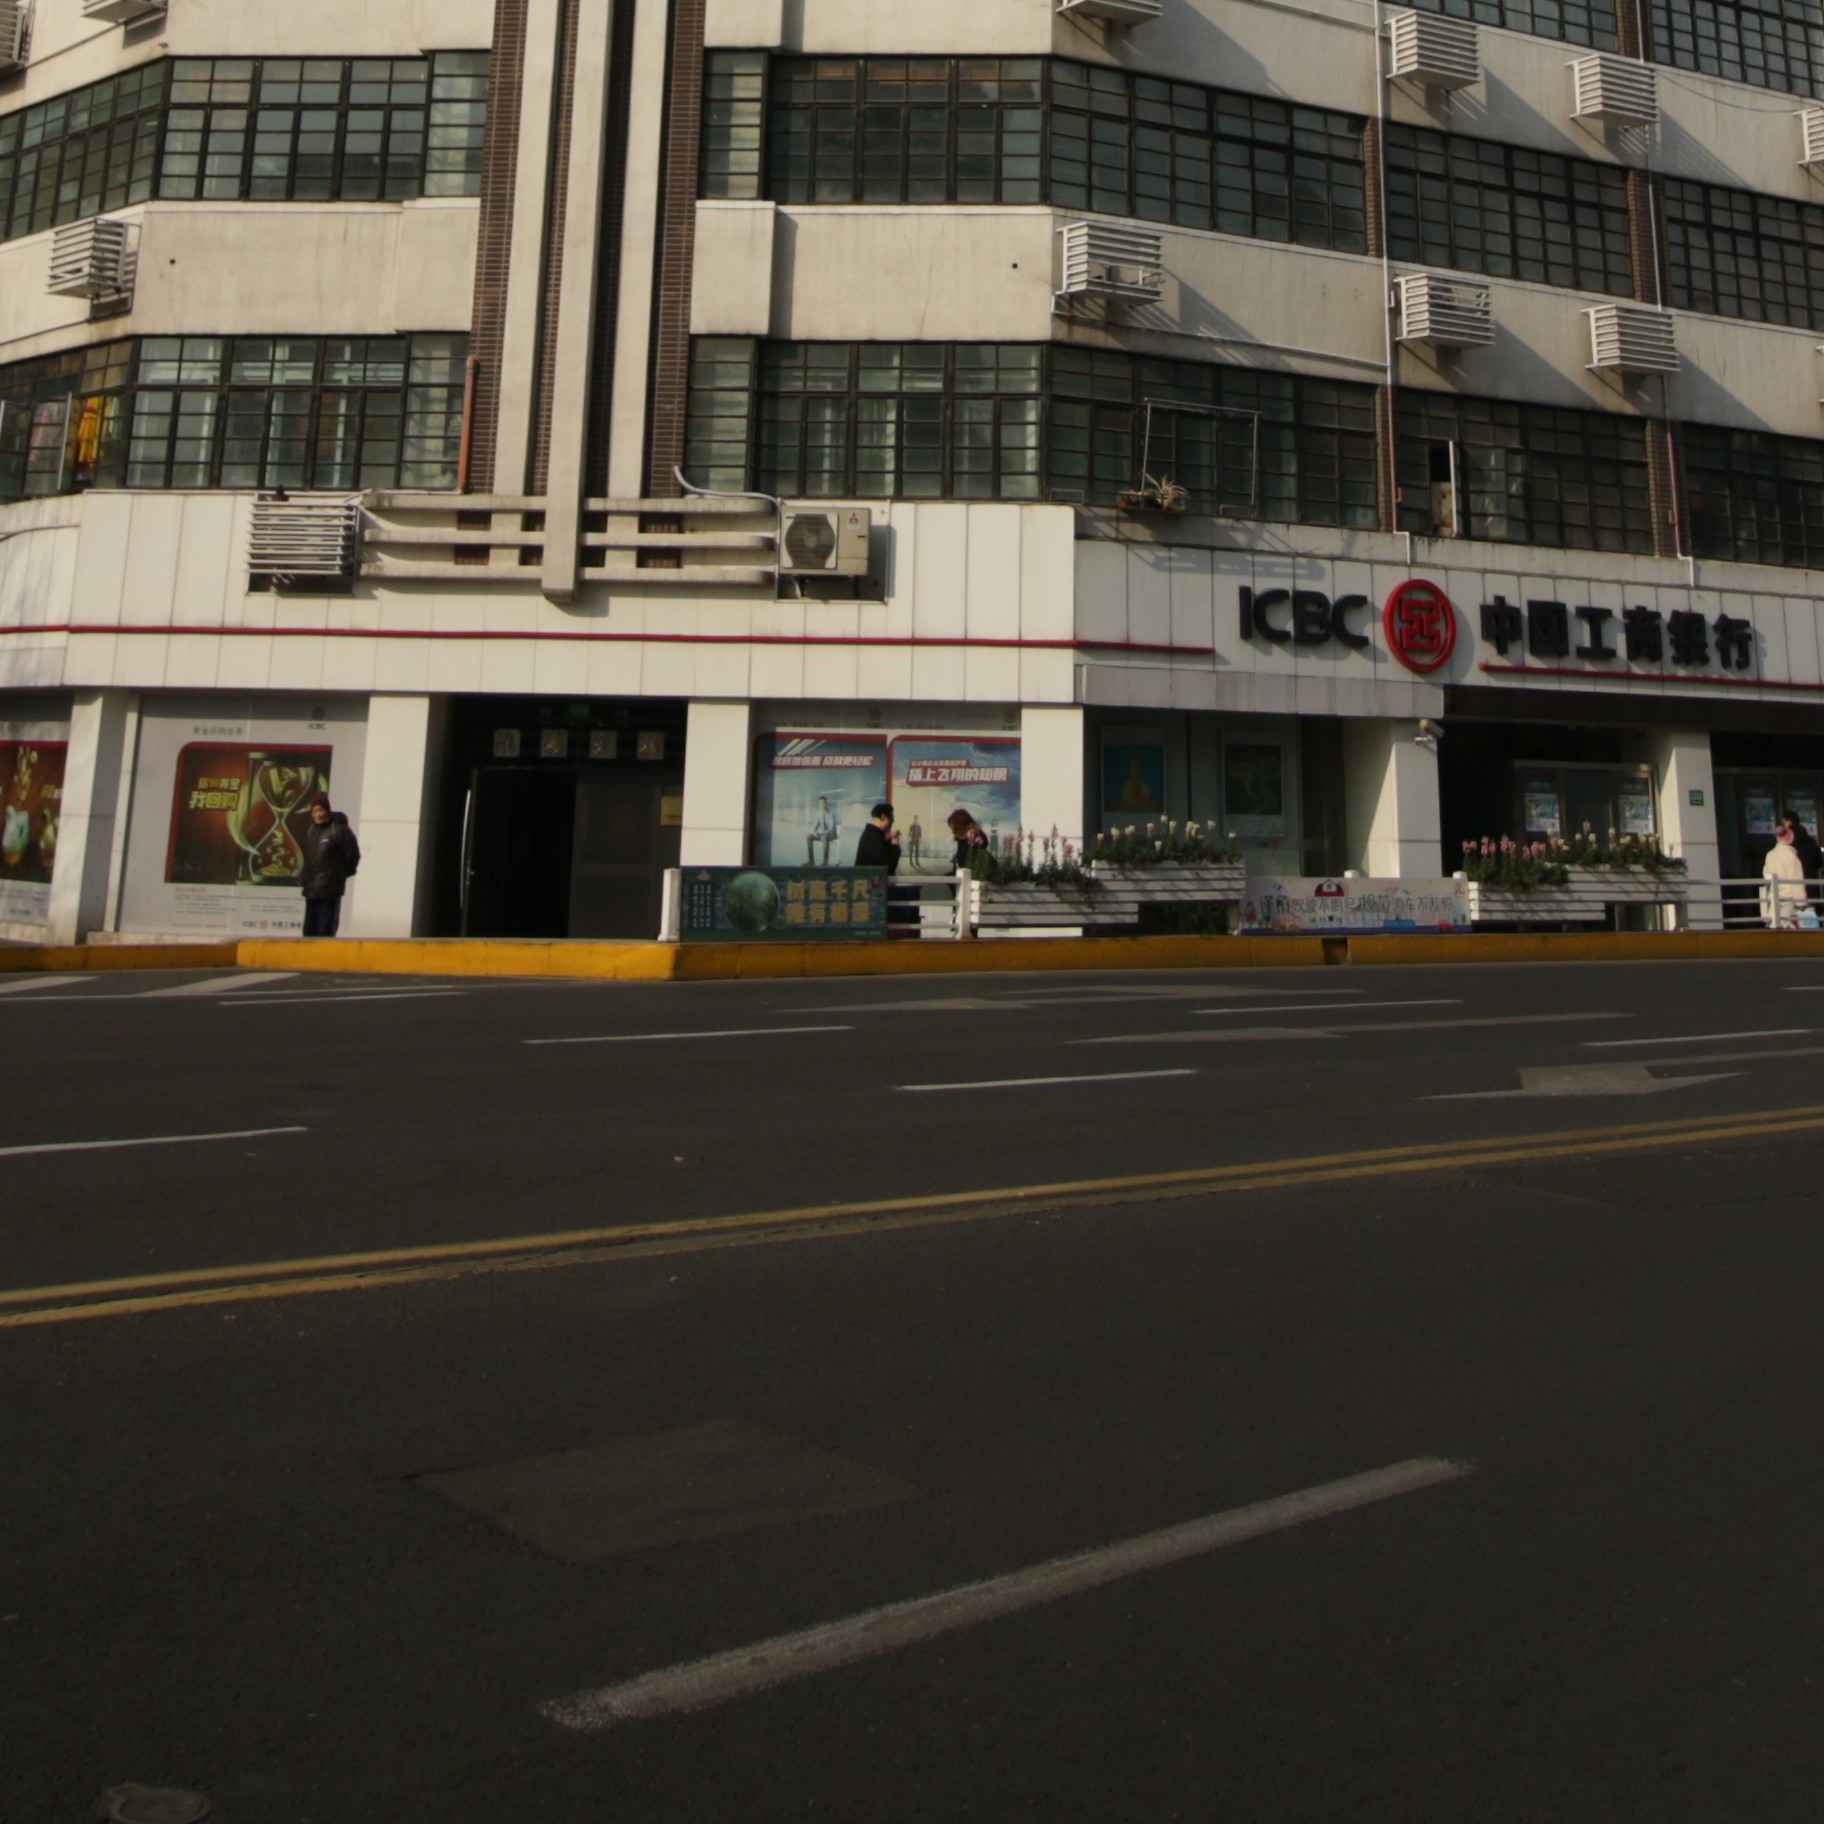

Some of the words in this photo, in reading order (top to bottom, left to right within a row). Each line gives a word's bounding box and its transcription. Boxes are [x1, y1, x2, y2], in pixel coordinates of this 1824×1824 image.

[1238, 586, 1369, 648] ICBC
[1479, 595, 1752, 671] 中国工商银行
[189, 790, 240, 811] 我回购
